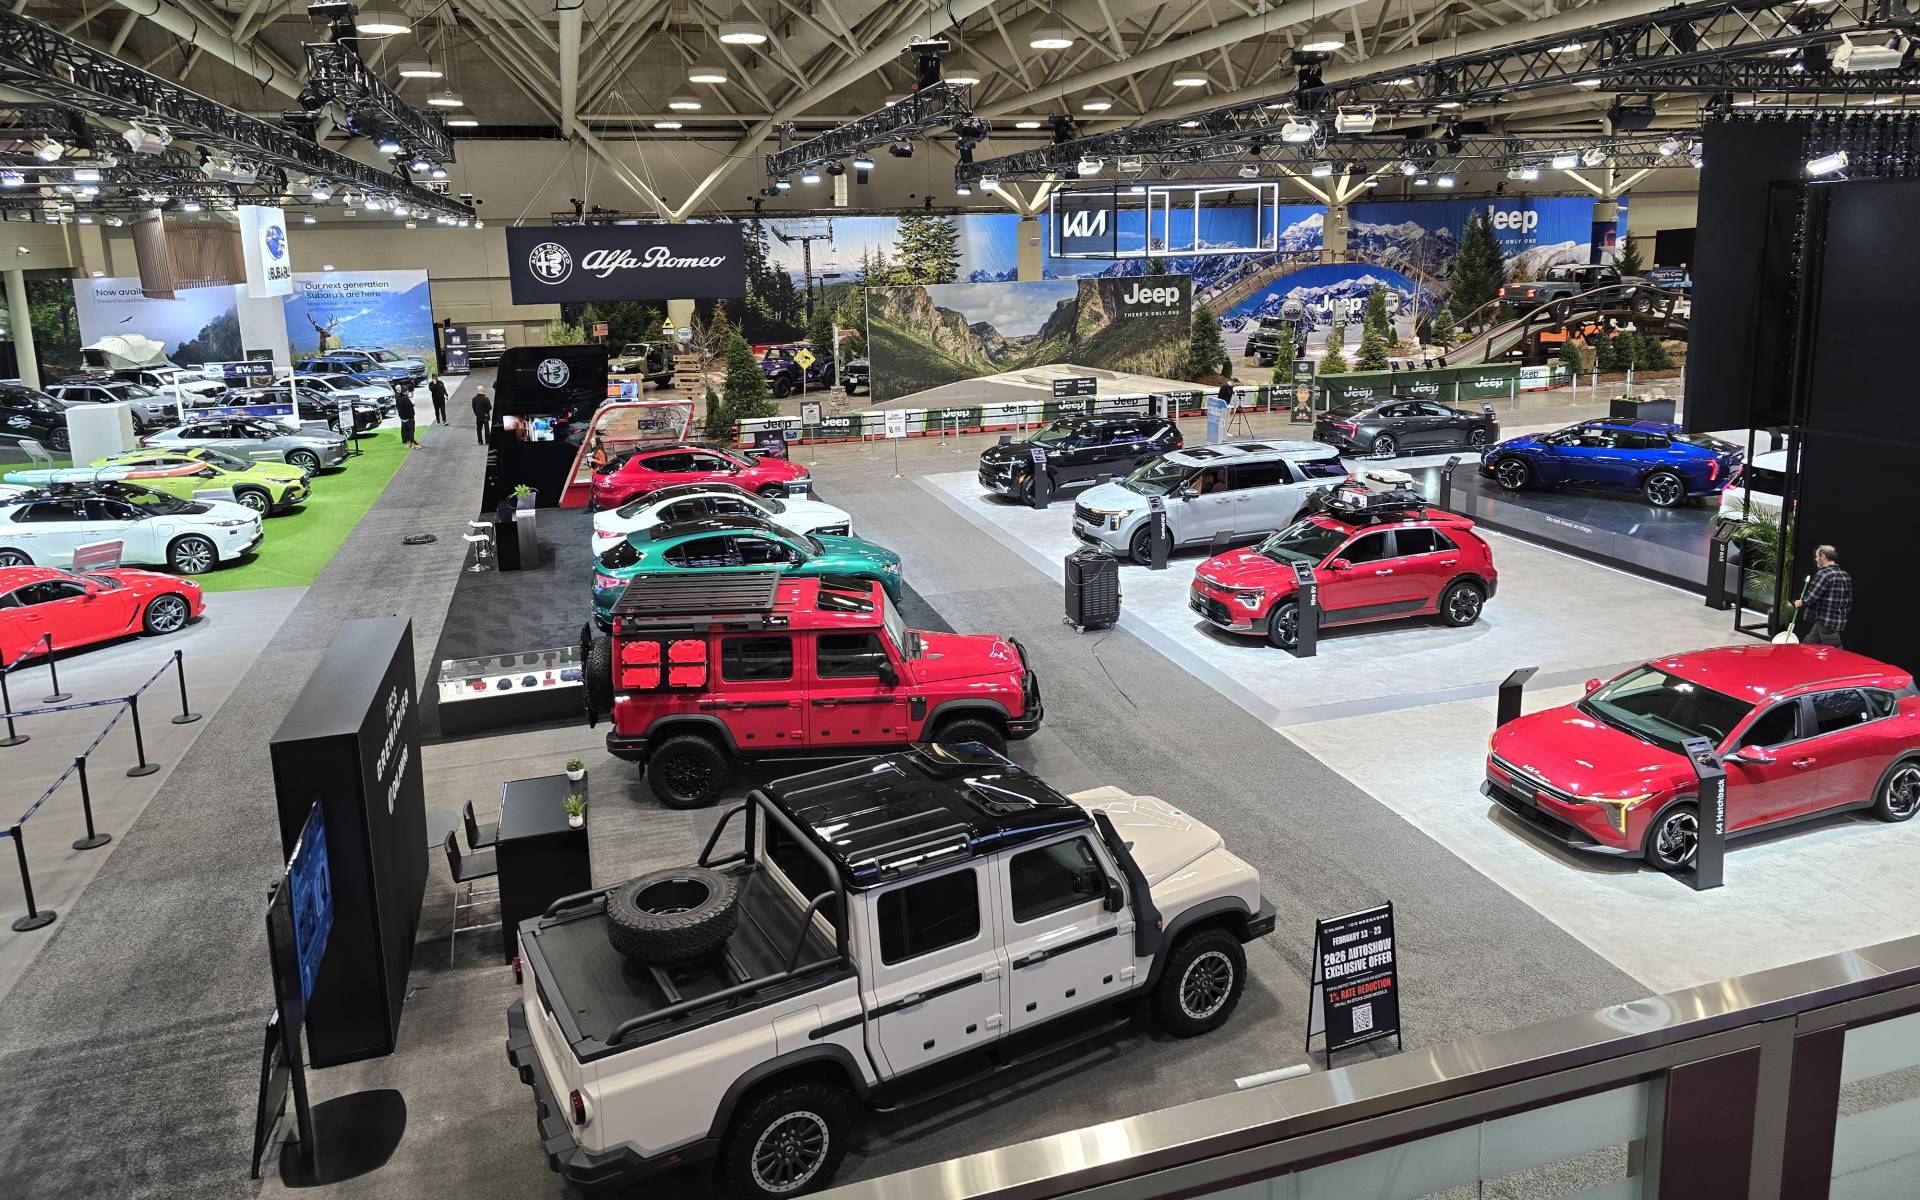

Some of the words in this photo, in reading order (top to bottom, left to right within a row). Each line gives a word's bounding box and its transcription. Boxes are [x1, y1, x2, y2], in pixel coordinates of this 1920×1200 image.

[581, 249, 641, 278] Alfa
[642, 246, 726, 268] Romeo
[305, 282, 321, 290] Our
[342, 281, 389, 290] generation
[96, 289, 116, 297] Now
[306, 291, 345, 299] Subaru's
[1124, 283, 1180, 307] Jeep
[1411, 381, 1440, 395] Jeep
[1475, 376, 1503, 388] Jeep
[1168, 392, 1192, 402] Jeep
[1343, 385, 1373, 399] Jeep
[1059, 399, 1084, 411] Jeep
[1114, 396, 1138, 406] Jeep
[943, 408, 970, 418] Jeep
[822, 416, 850, 427] Jeep
[377, 688, 409, 782] GRENADIER
[1716, 778, 1725, 821] Hatchback
[1715, 822, 1724, 835] K4
[1332, 931, 1360, 946] FEBRUARY
[1361, 929, 1368, 939] 13
[1374, 925, 1382, 935] 23
[1324, 950, 1346, 966] 2026
[1348, 937, 1392, 961] AUTOSHOW
[1325, 958, 1367, 980] EXCLUSIVE
[1368, 951, 1393, 968] OFFER
[1329, 991, 1340, 1003] 1%
[1341, 987, 1356, 1000] RATE
[1357, 977, 1392, 994] REDUCTION
